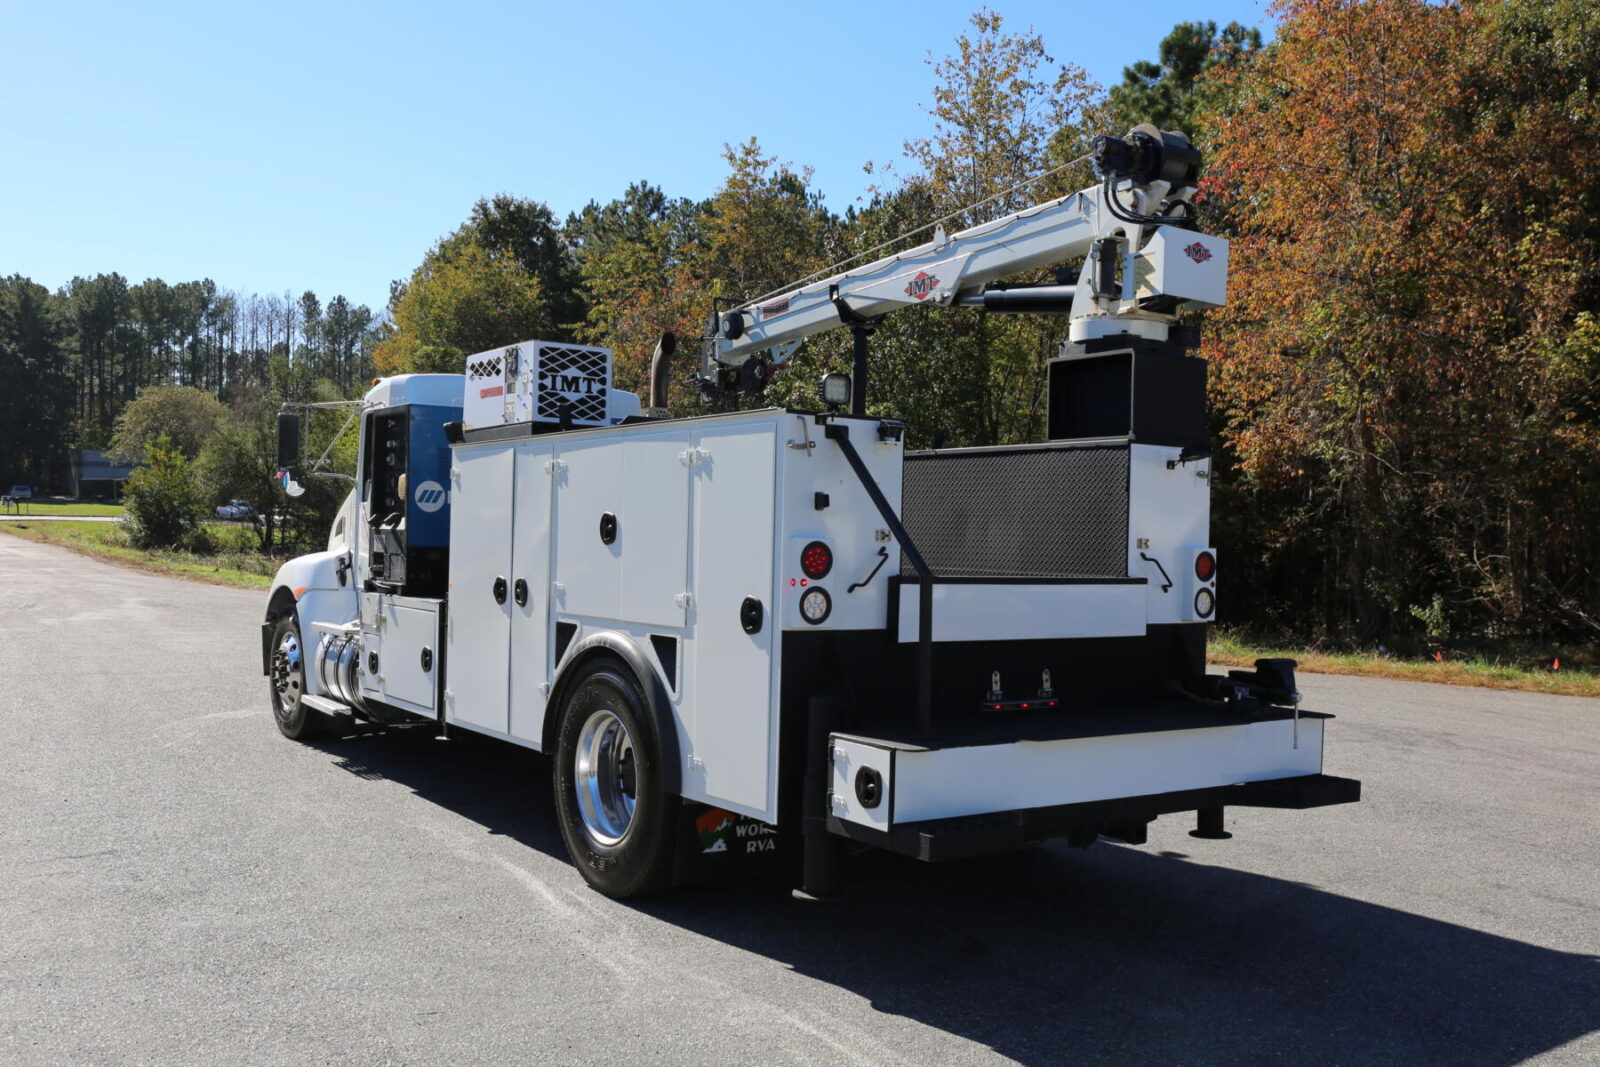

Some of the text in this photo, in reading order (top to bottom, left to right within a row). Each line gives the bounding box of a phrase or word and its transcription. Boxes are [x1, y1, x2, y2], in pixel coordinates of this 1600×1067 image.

[1186, 244, 1210, 262] IMT
[908, 275, 936, 297] IMT
[549, 374, 597, 394] IMT
[746, 838, 776, 853] RVA
